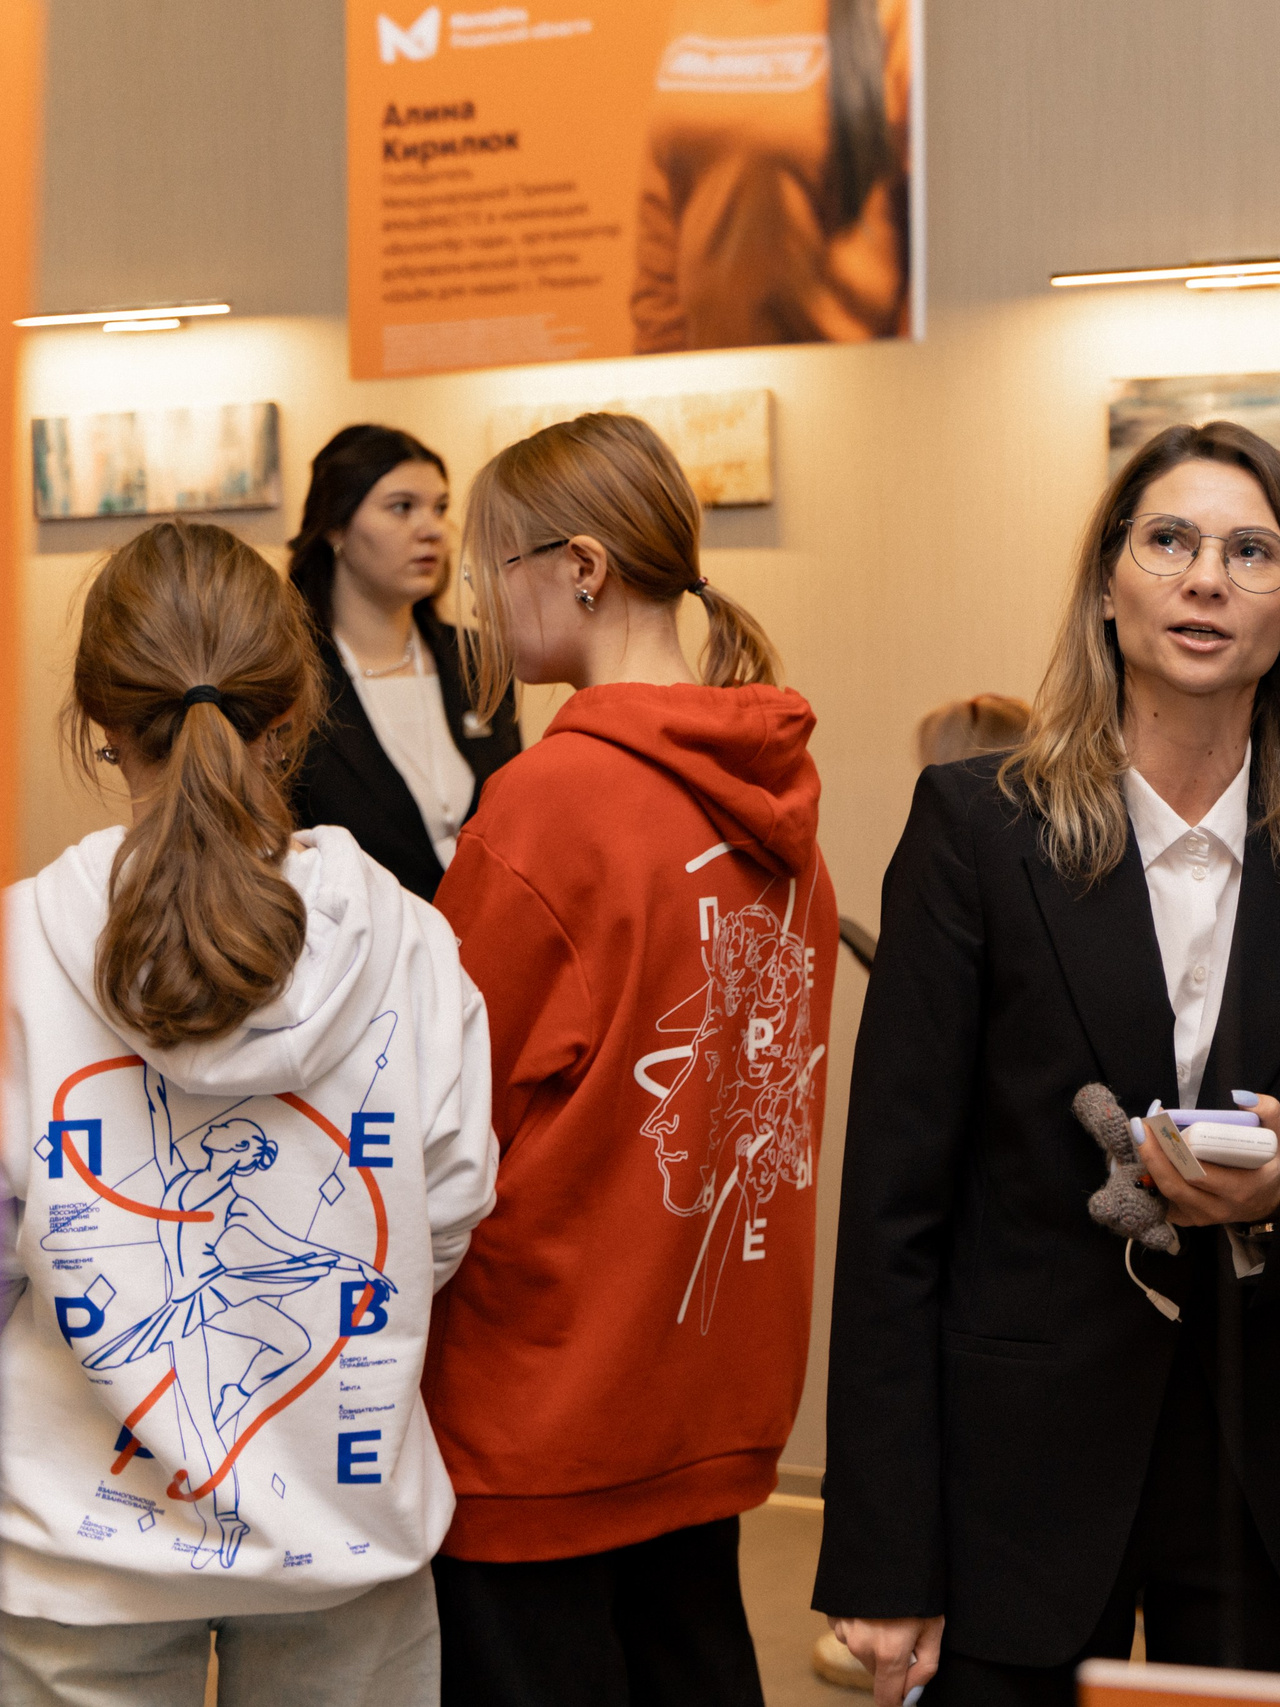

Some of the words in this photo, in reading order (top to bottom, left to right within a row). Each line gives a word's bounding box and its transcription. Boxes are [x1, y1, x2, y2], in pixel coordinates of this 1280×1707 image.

[383, 101, 476, 128] Алина
[383, 130, 519, 168] Кирилюк
[747, 1017, 775, 1061] Р
[48, 1118, 102, 1179] П
[348, 1112, 395, 1168] Е
[742, 1218, 767, 1262] Е
[54, 1296, 105, 1350] Р
[339, 1280, 389, 1337] В
[337, 1429, 382, 1484] Е
